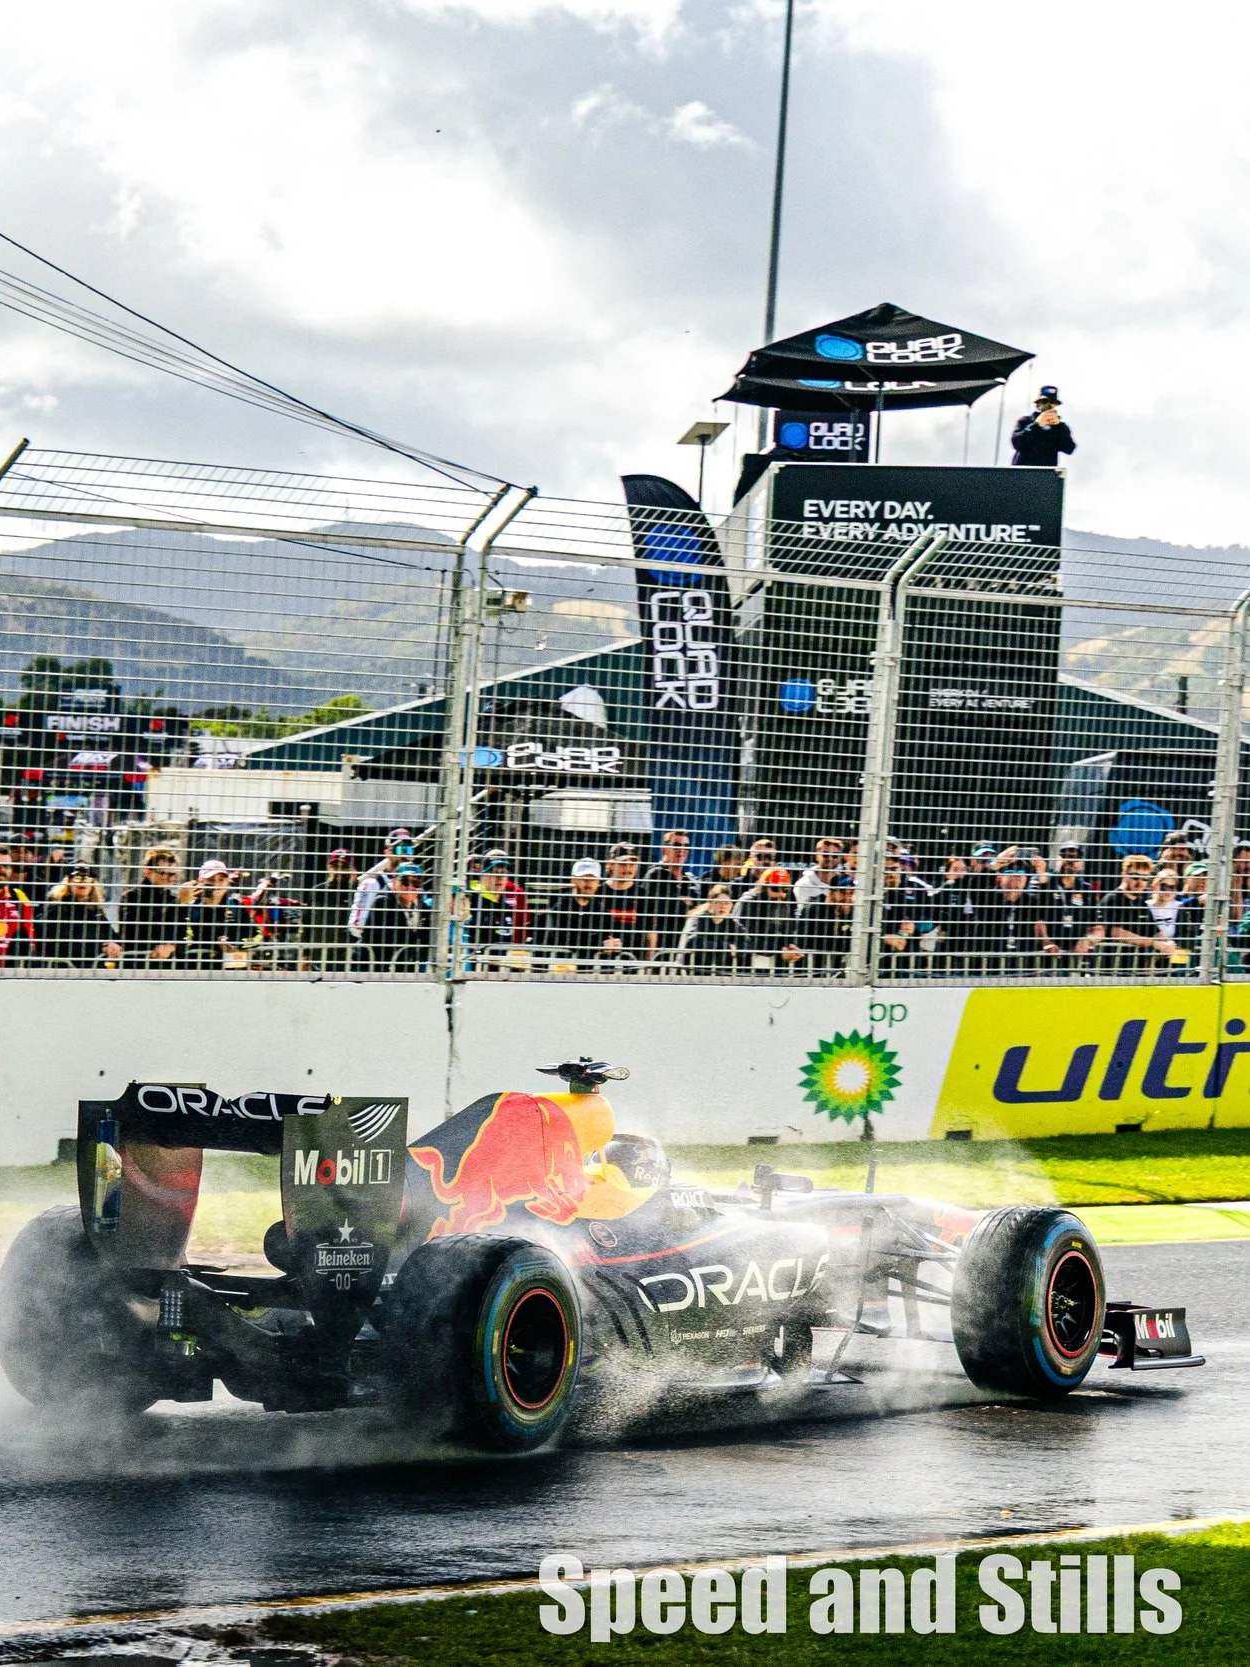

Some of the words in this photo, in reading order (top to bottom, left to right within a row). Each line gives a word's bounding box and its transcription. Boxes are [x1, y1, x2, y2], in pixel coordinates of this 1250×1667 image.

[866, 333, 963, 353] QUAD
[866, 345, 966, 363] LOCK
[803, 500, 882, 518] EVERY
[883, 501, 934, 520] DAY.
[803, 522, 881, 541] EVERY
[650, 591, 686, 709] LOCK
[682, 591, 719, 709] QUAD
[817, 679, 875, 696] QUA
[816, 696, 872, 713] LOC
[47, 715, 121, 732] FINISH
[507, 742, 620, 762] QUAD
[507, 756, 623, 773] LOCK
[138, 1085, 326, 1121] ORACLE
[294, 1150, 365, 1185] Mobil
[318, 1250, 370, 1266] Heineken
[335, 1273, 351, 1290] 0.0
[637, 1254, 830, 1313] ORACLE
[1134, 1313, 1176, 1339] Mobil
